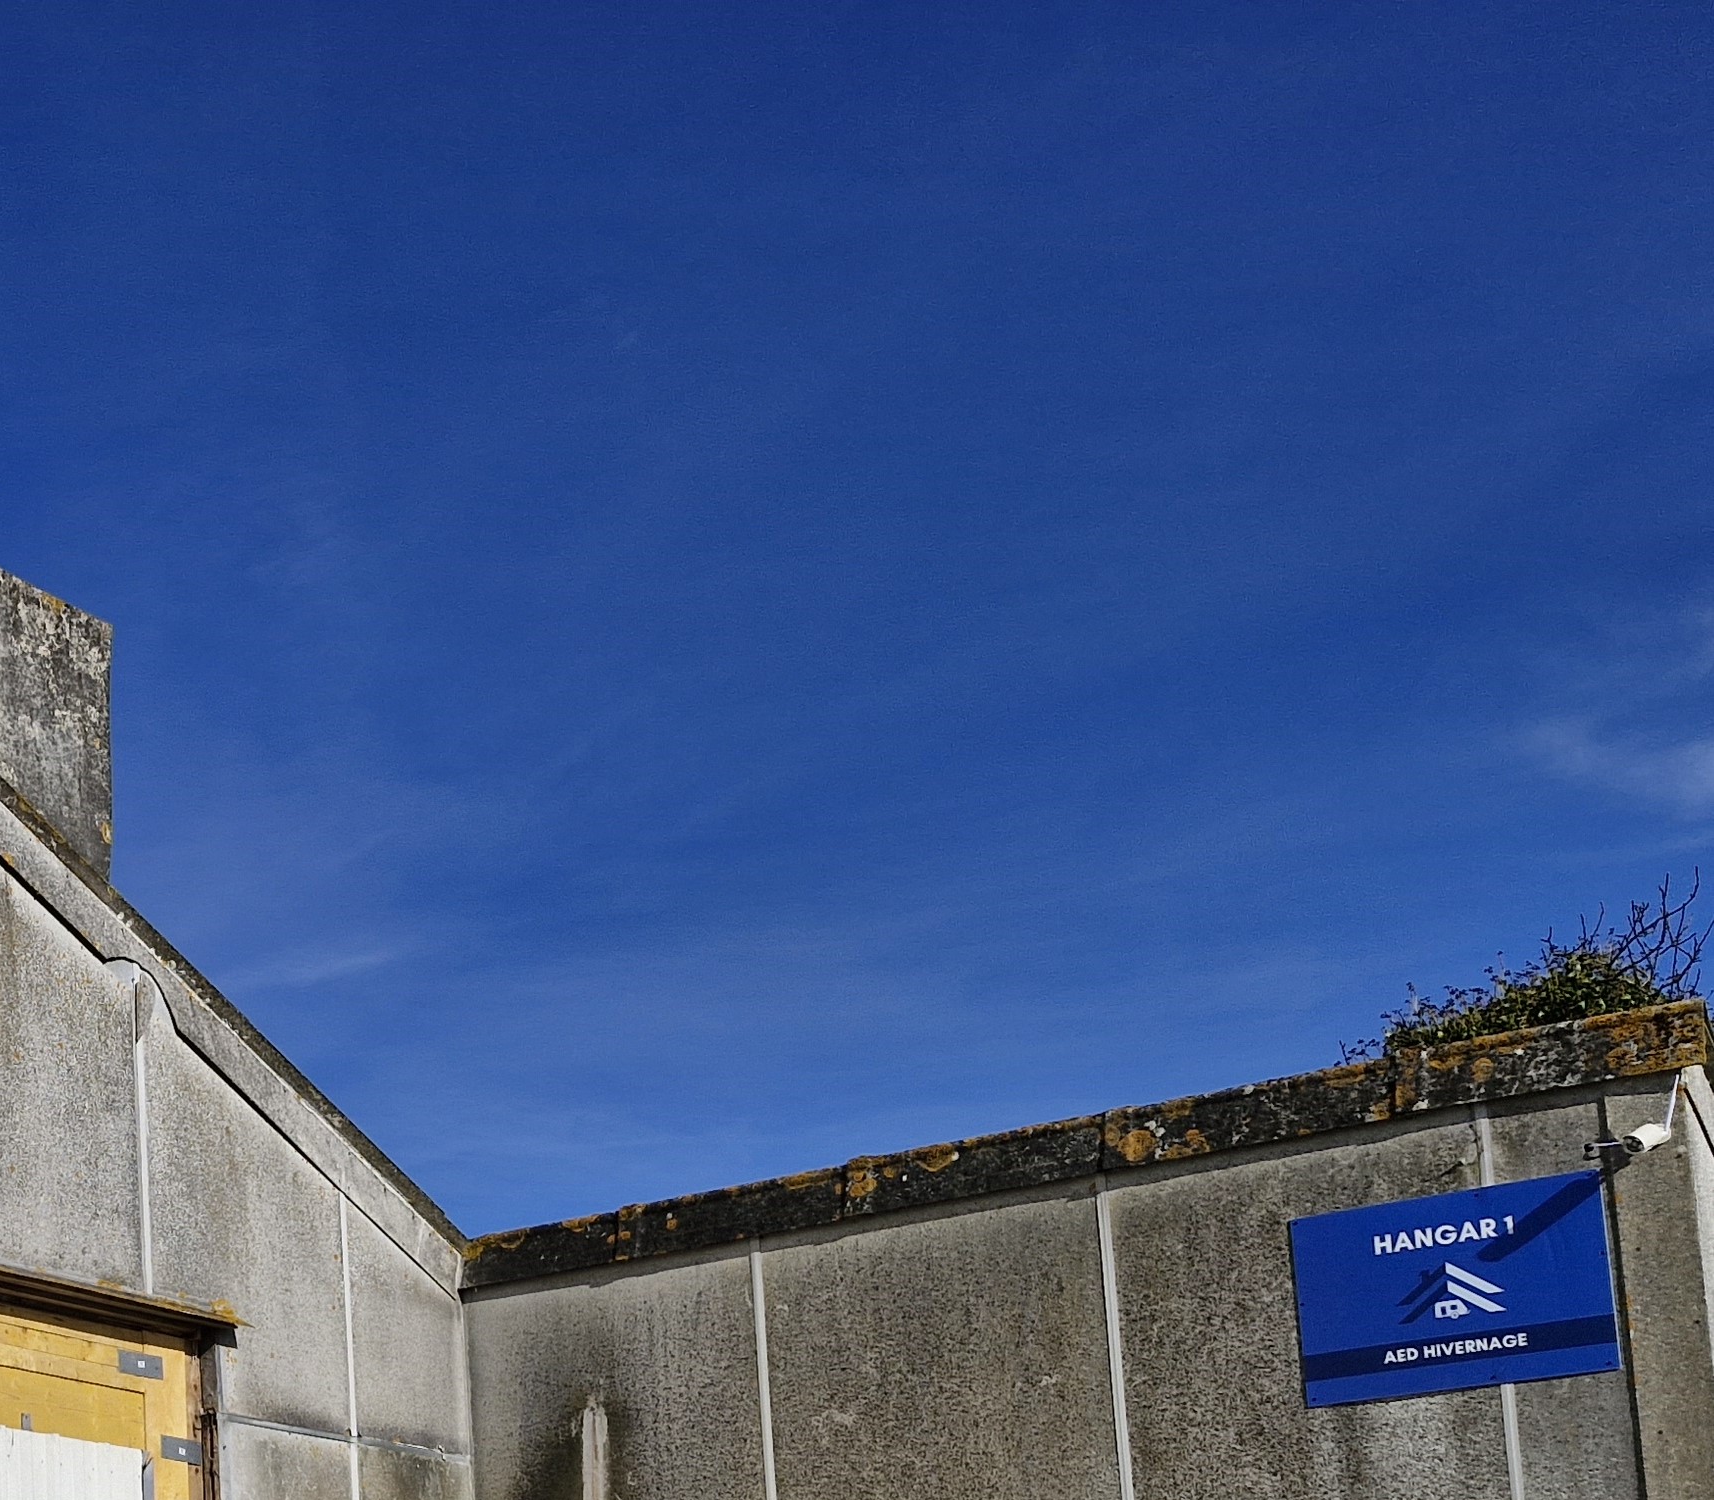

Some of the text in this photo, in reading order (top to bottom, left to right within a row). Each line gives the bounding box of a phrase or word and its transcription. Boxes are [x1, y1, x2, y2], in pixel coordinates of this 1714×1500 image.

[1373, 1215, 1514, 1256] HANGAR 1
[1383, 1333, 1528, 1365] AED HIVERNAGE
